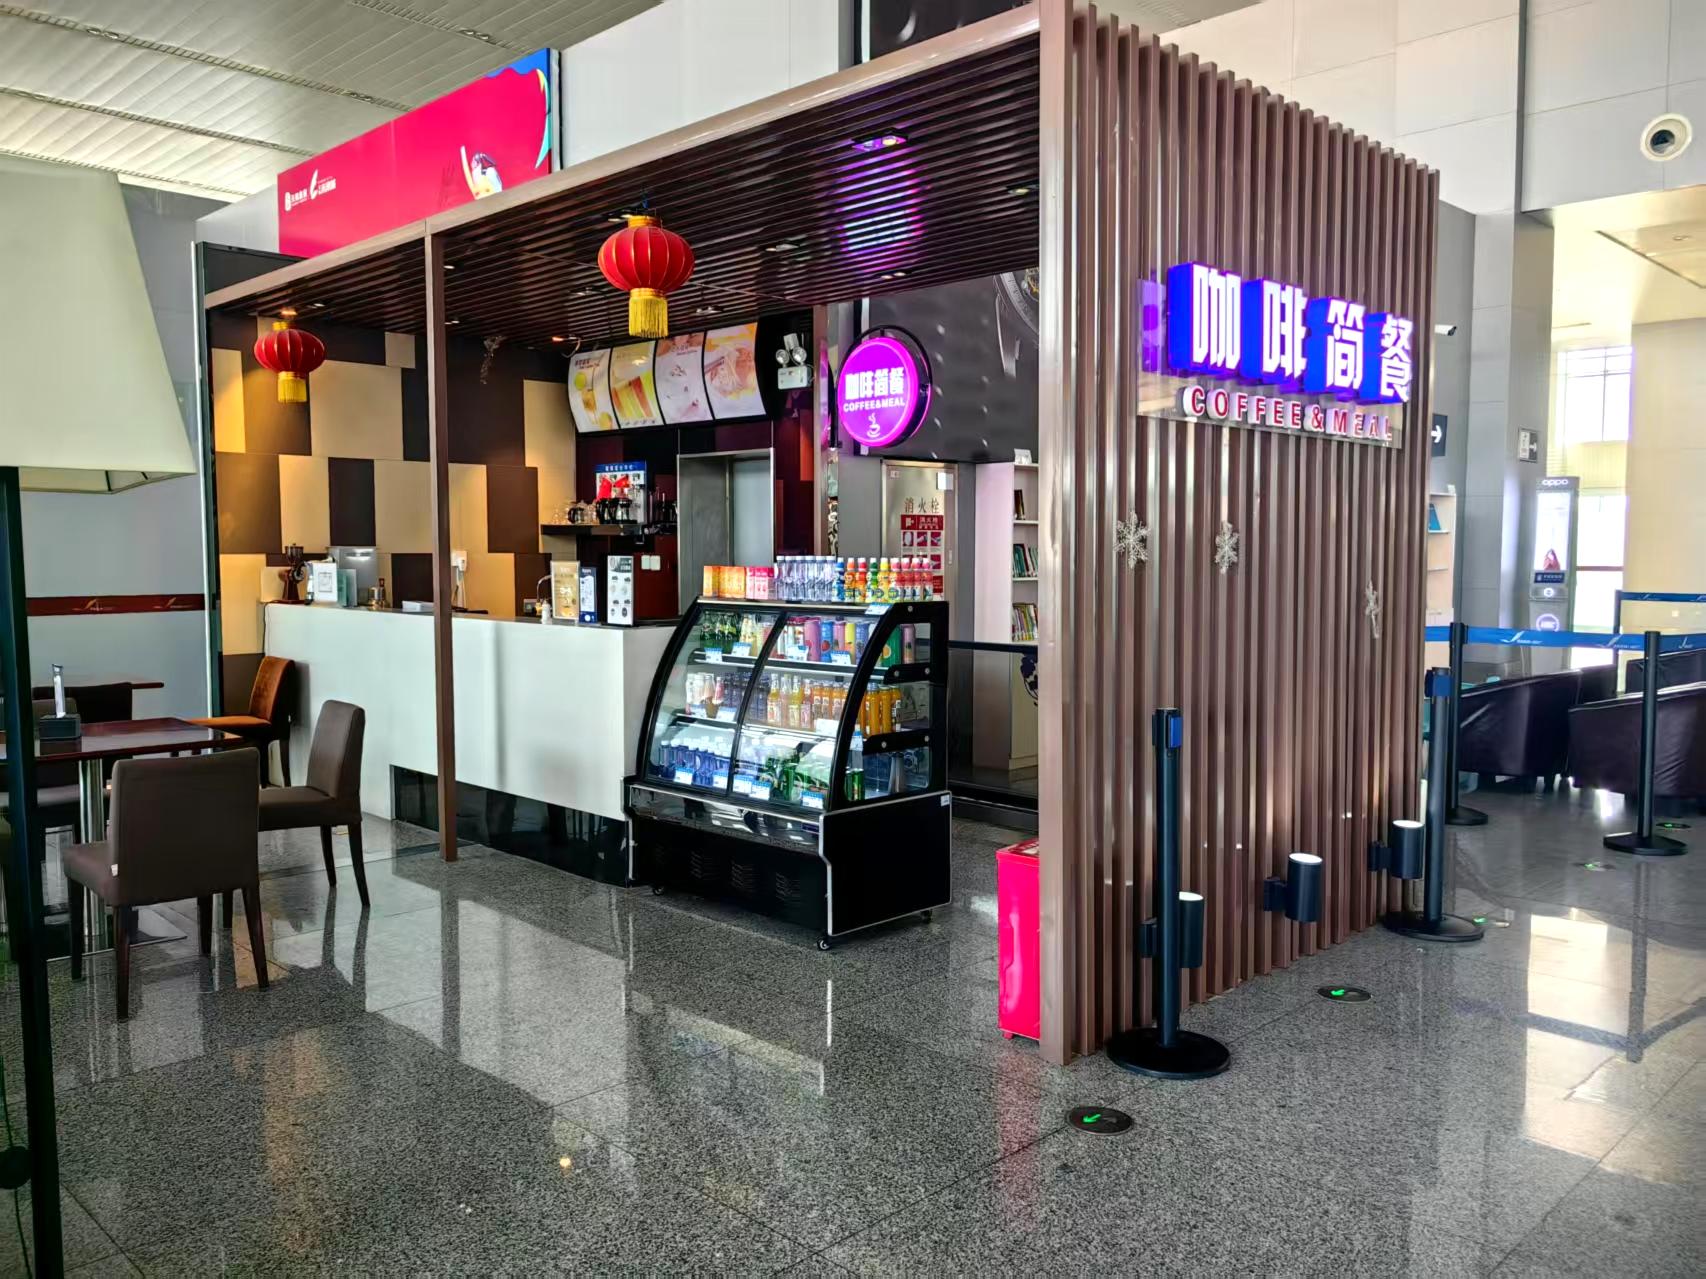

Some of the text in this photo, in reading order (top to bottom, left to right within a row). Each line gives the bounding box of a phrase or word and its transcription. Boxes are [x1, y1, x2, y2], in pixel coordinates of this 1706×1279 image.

[1192, 263, 1414, 402] 咖啡简餐
[843, 397, 905, 412] COFFEE&MEAL
[1190, 384, 1393, 440] COFFEE&MEAL
[904, 497, 940, 513] 消火栓
